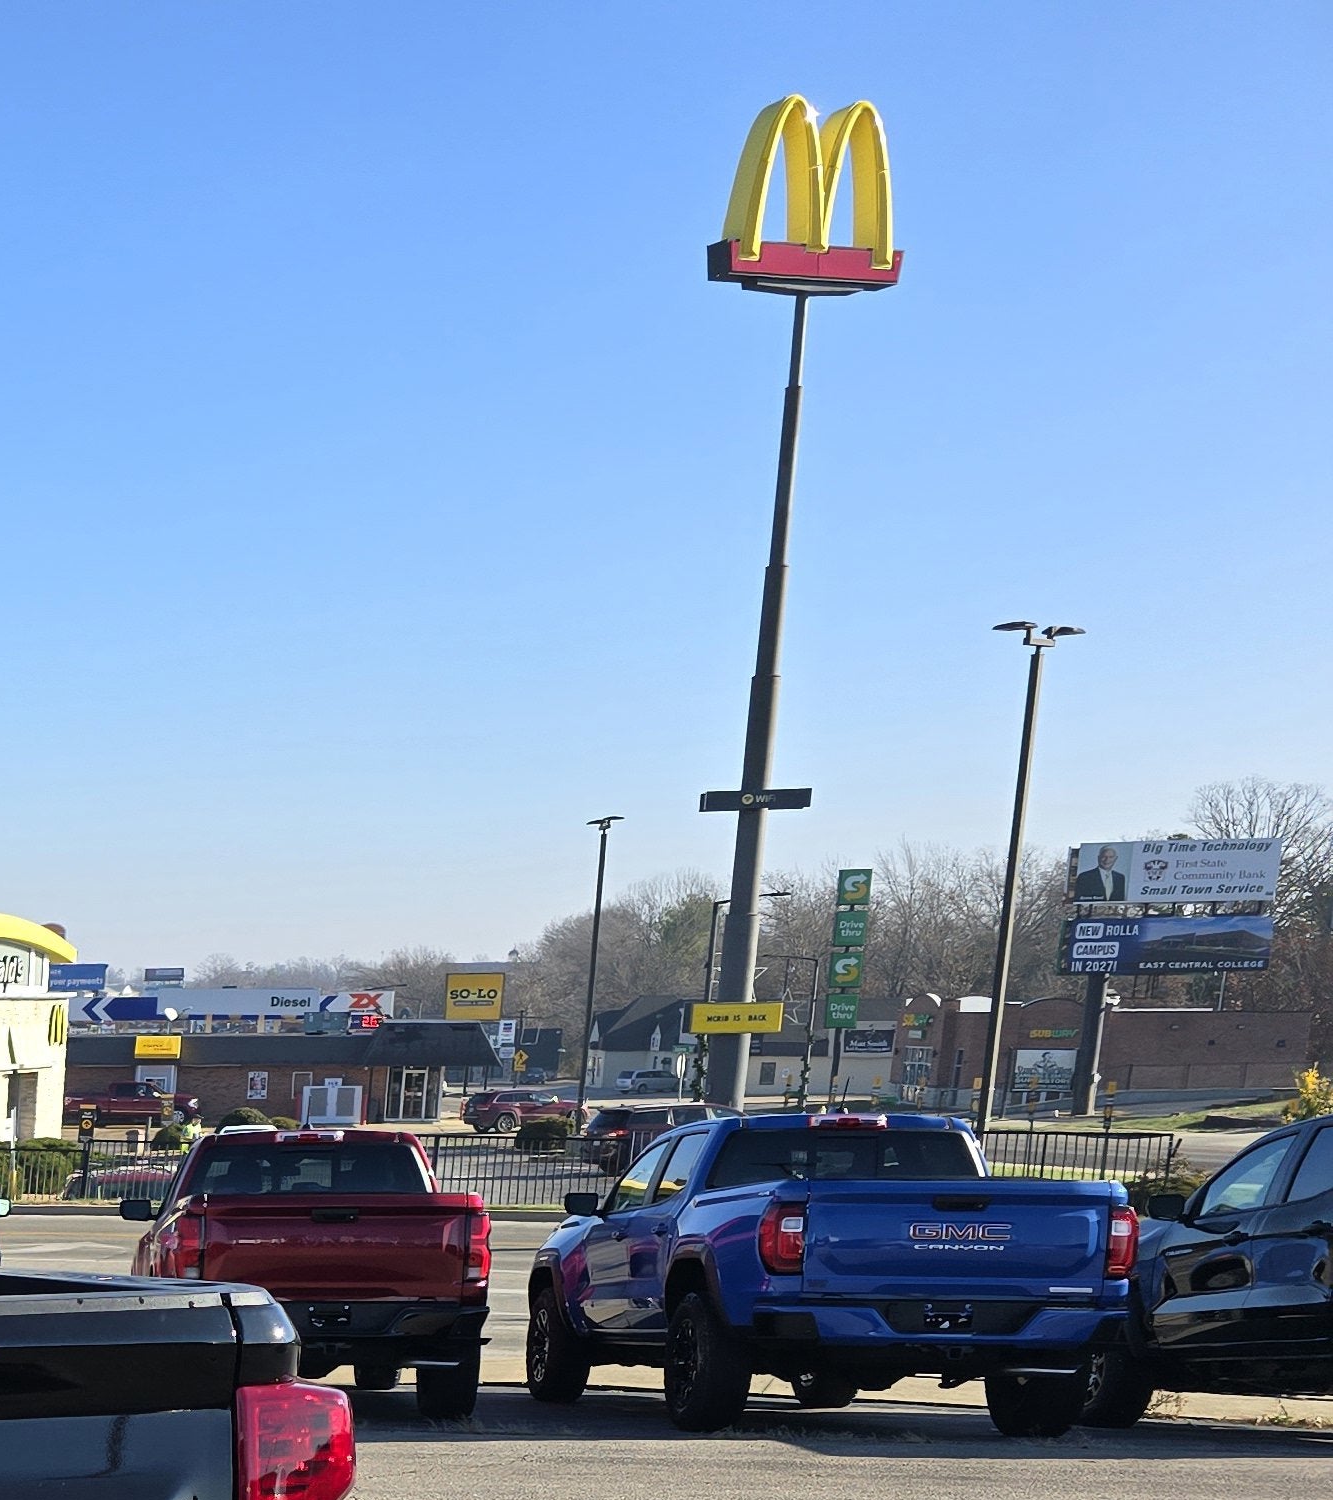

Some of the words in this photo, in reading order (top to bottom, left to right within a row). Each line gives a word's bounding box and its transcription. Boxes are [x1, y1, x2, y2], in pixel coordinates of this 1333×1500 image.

[1142, 843, 1163, 855] Big
[1168, 842, 1197, 853] Time
[1201, 840, 1273, 852] Technology
[1176, 859, 1198, 869] First
[1200, 858, 1228, 868] State
[1173, 870, 1236, 881] Community
[1238, 869, 1267, 880] Bank
[1140, 885, 1177, 896] Small
[1180, 884, 1213, 895] Town
[1216, 883, 1264, 895] Service
[839, 920, 865, 929] Drive
[840, 928, 862, 937] thru
[1078, 925, 1102, 937] NEW
[1106, 924, 1139, 936] ROLLA
[1076, 944, 1117, 956] CAMPUS
[1070, 960, 1083, 972] IN
[1085, 960, 1118, 972] 2027!
[1139, 961, 1166, 969] EAST
[1168, 961, 1214, 969] CENTRAL
[1217, 960, 1264, 968] COLLEGE
[449, 988, 498, 1000] SO-LO
[270, 995, 312, 1009] Diesel
[830, 1003, 856, 1011] Drive
[733, 1014, 741, 1022] IS
[748, 1014, 767, 1022] BACK
[831, 1011, 853, 1020] thru
[1029, 1029, 1079, 1039] SUBWAY
[909, 1222, 1013, 1241] GMC
[913, 1243, 1005, 1252] CANYON
